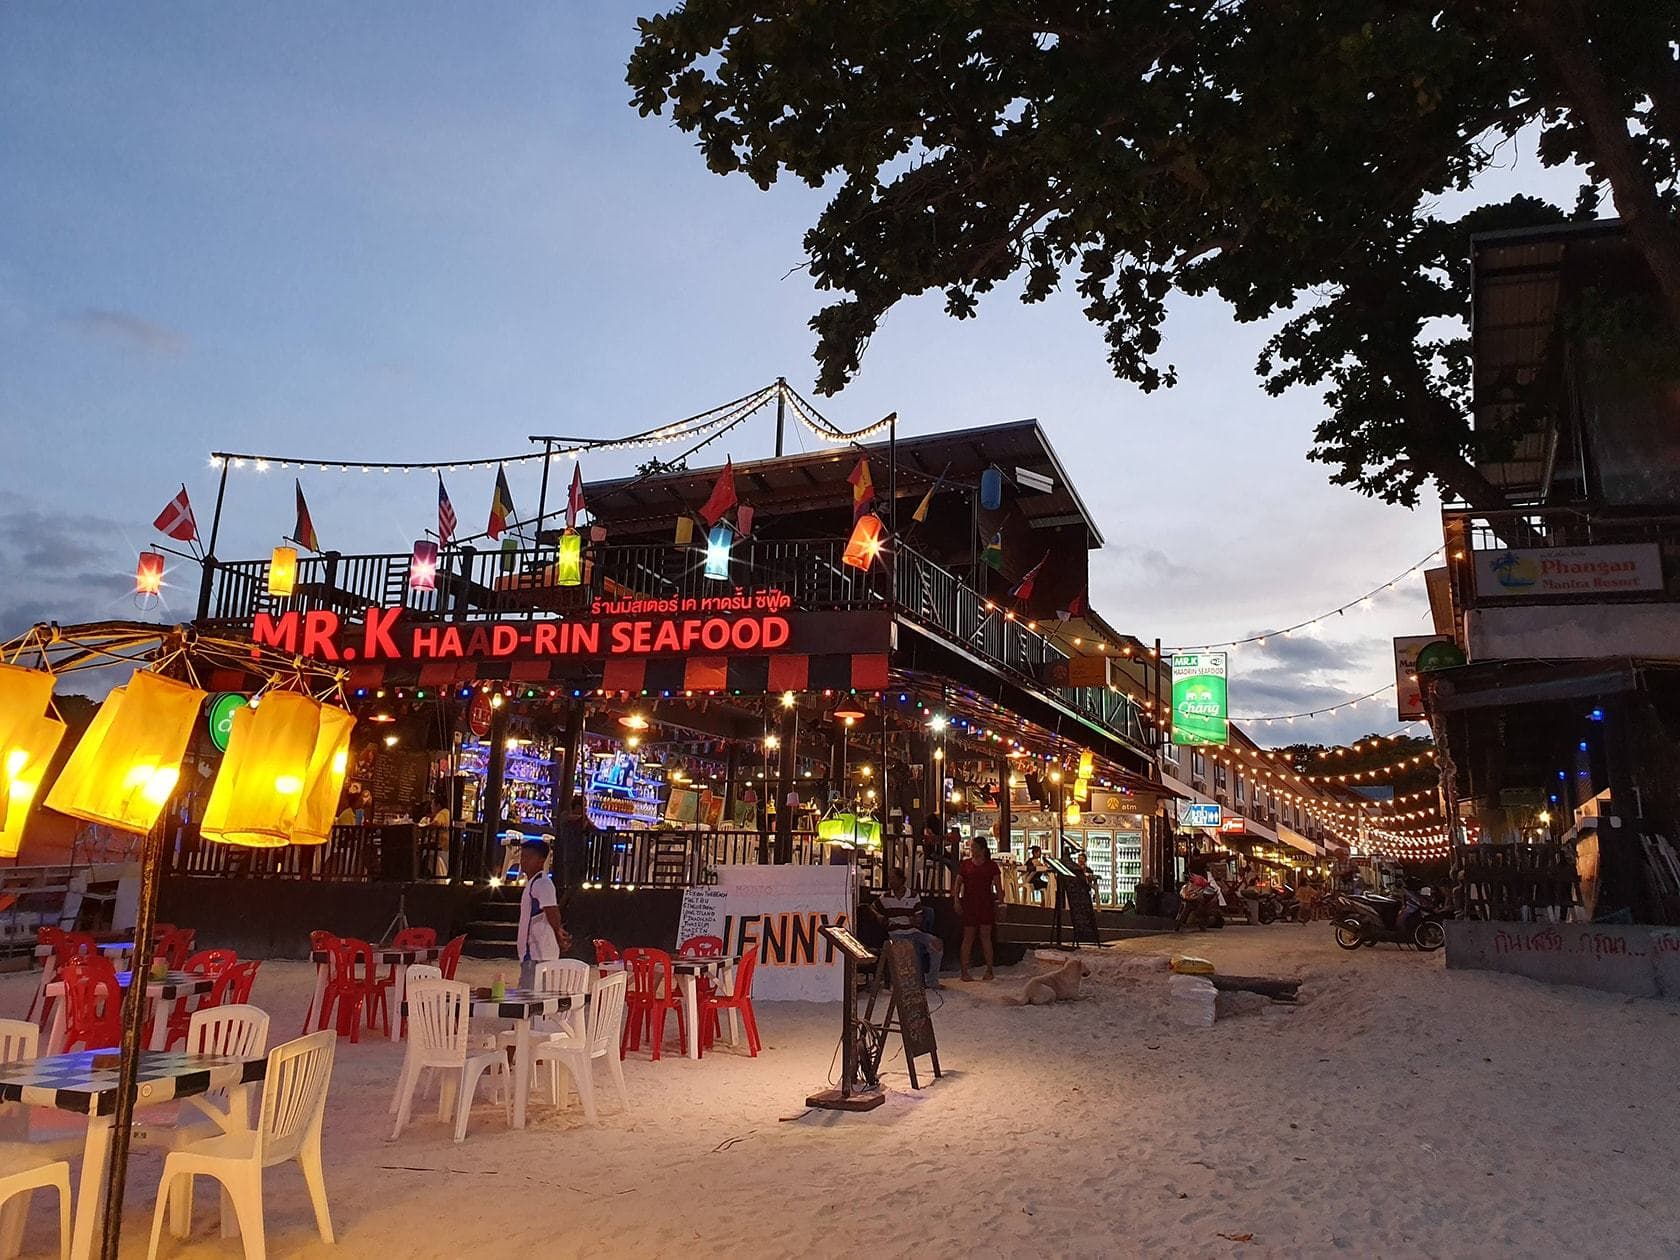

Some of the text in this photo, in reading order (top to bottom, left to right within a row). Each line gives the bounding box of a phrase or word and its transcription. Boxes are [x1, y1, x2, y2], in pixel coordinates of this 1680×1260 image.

[1541, 558, 1636, 575] Phangan
[1593, 577, 1640, 588] Resort
[591, 594, 679, 614] ร้านมิสเตอร์
[682, 598, 697, 611] เค
[252, 607, 403, 661] MR.K
[412, 616, 790, 658] HAAD-RIN SEAFOOD
[1174, 656, 1198, 666] MR.K
[1198, 667, 1225, 675] SEAFOOD
[1178, 701, 1220, 716] Chang
